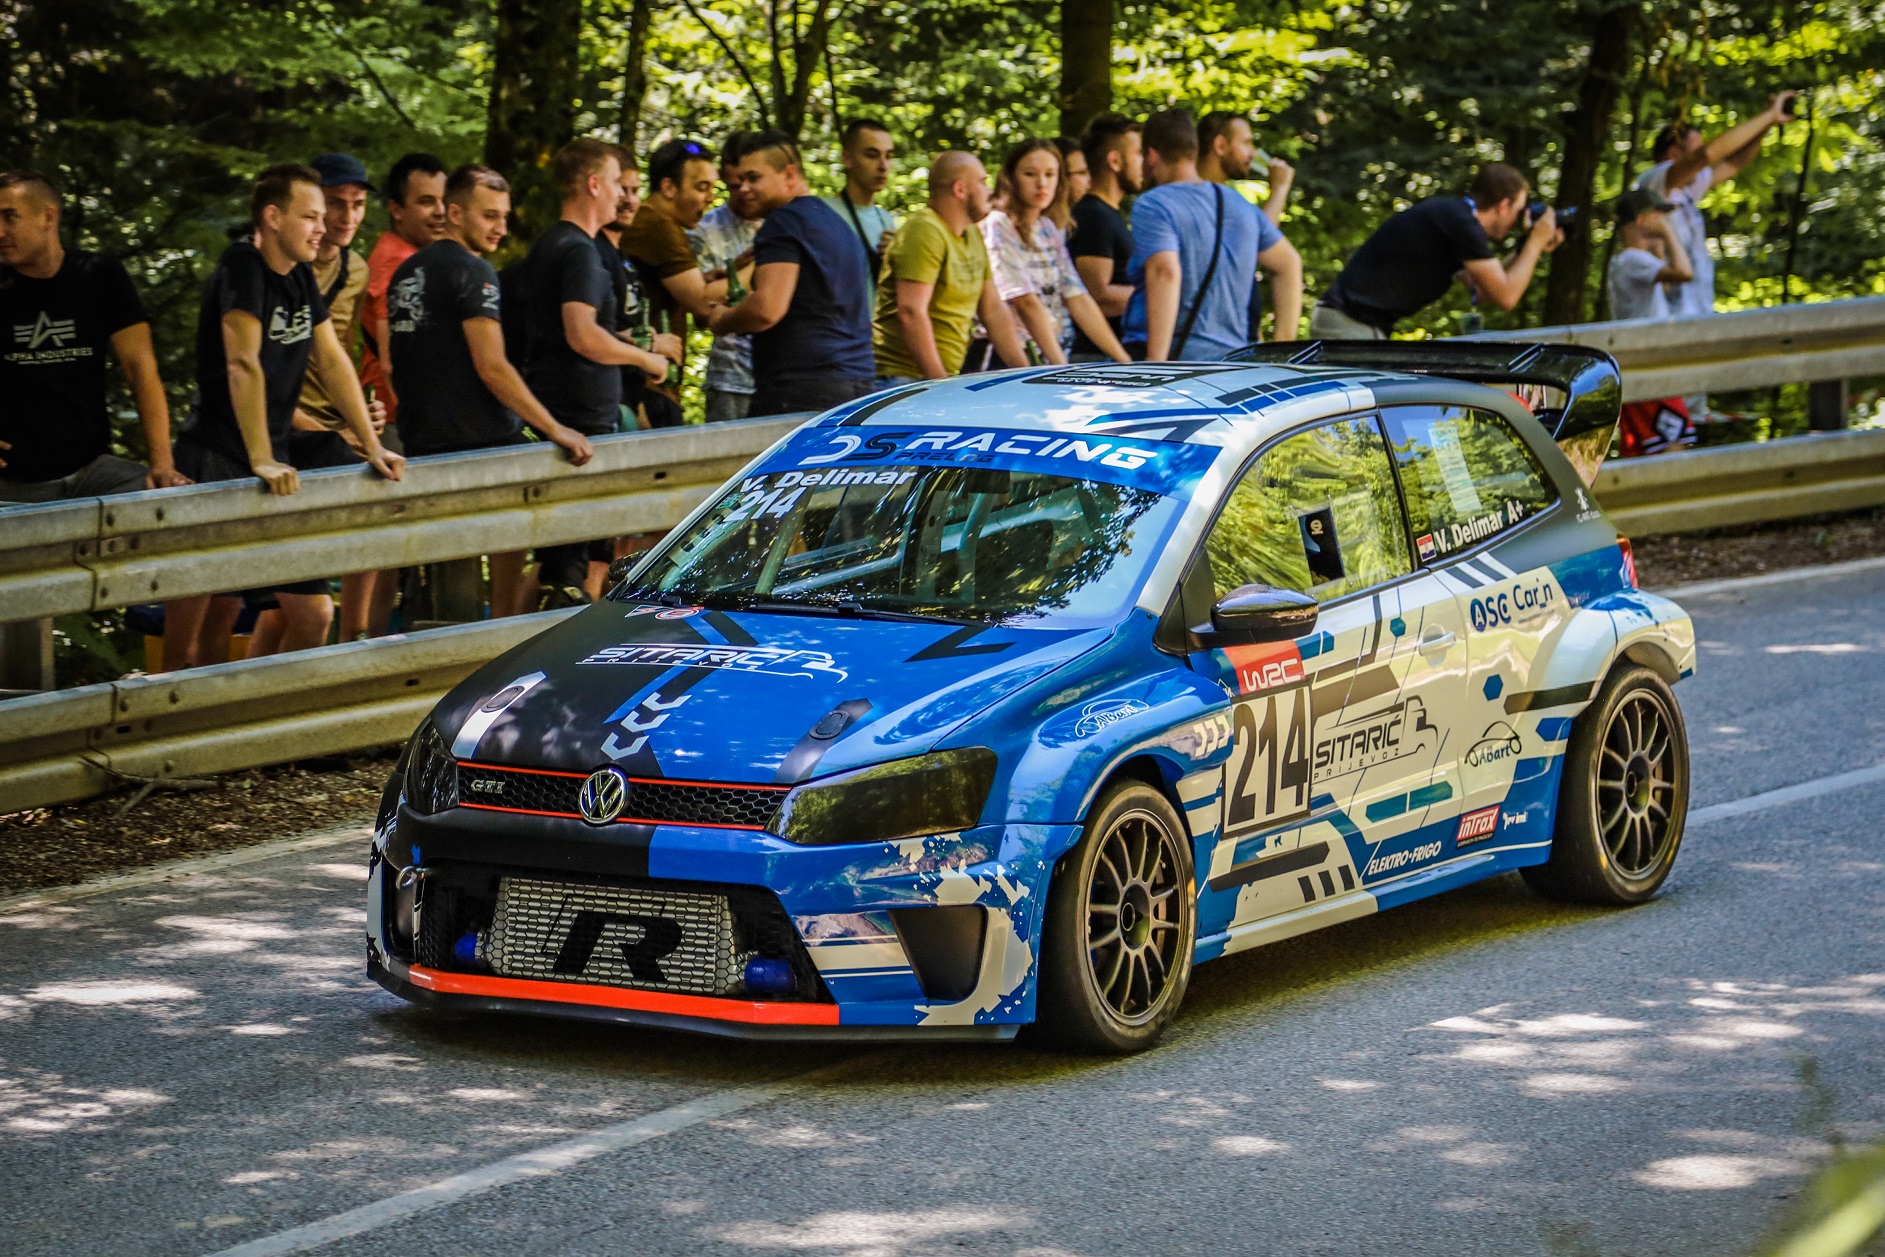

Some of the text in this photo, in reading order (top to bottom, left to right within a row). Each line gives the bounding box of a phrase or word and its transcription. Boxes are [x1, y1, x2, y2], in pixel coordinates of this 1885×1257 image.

[893, 451, 995, 463] PRELOG
[904, 431, 1158, 470] RACING
[774, 468, 918, 488] Delimar
[723, 487, 807, 522] 214
[1434, 499, 1524, 554] V. Delimar A+
[1242, 657, 1299, 692] WRC
[1227, 686, 1310, 827] 214
[1314, 713, 1402, 769] SITARIĆ
[1479, 744, 1511, 765] ABart
[1313, 748, 1400, 782] PRIJEVOZ
[470, 779, 506, 795] GTI
